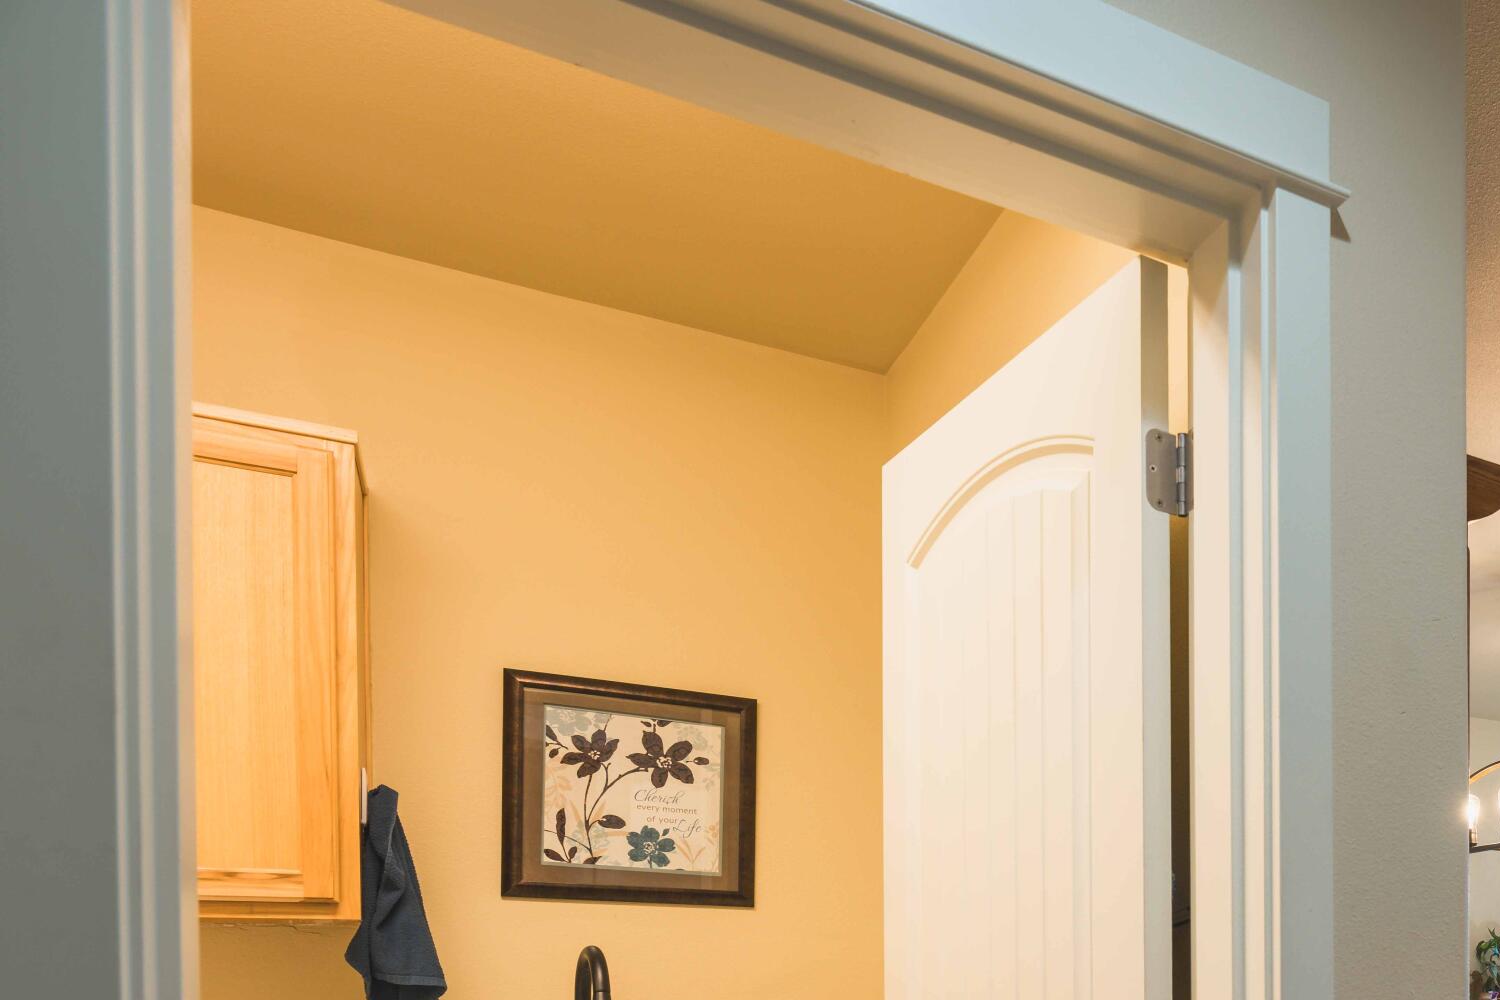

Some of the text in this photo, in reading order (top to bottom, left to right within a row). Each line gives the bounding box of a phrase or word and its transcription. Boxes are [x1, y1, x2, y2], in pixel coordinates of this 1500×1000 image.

[634, 788, 686, 805] Cherish
[636, 804, 697, 815] every moment
[672, 818, 702, 838] Life
